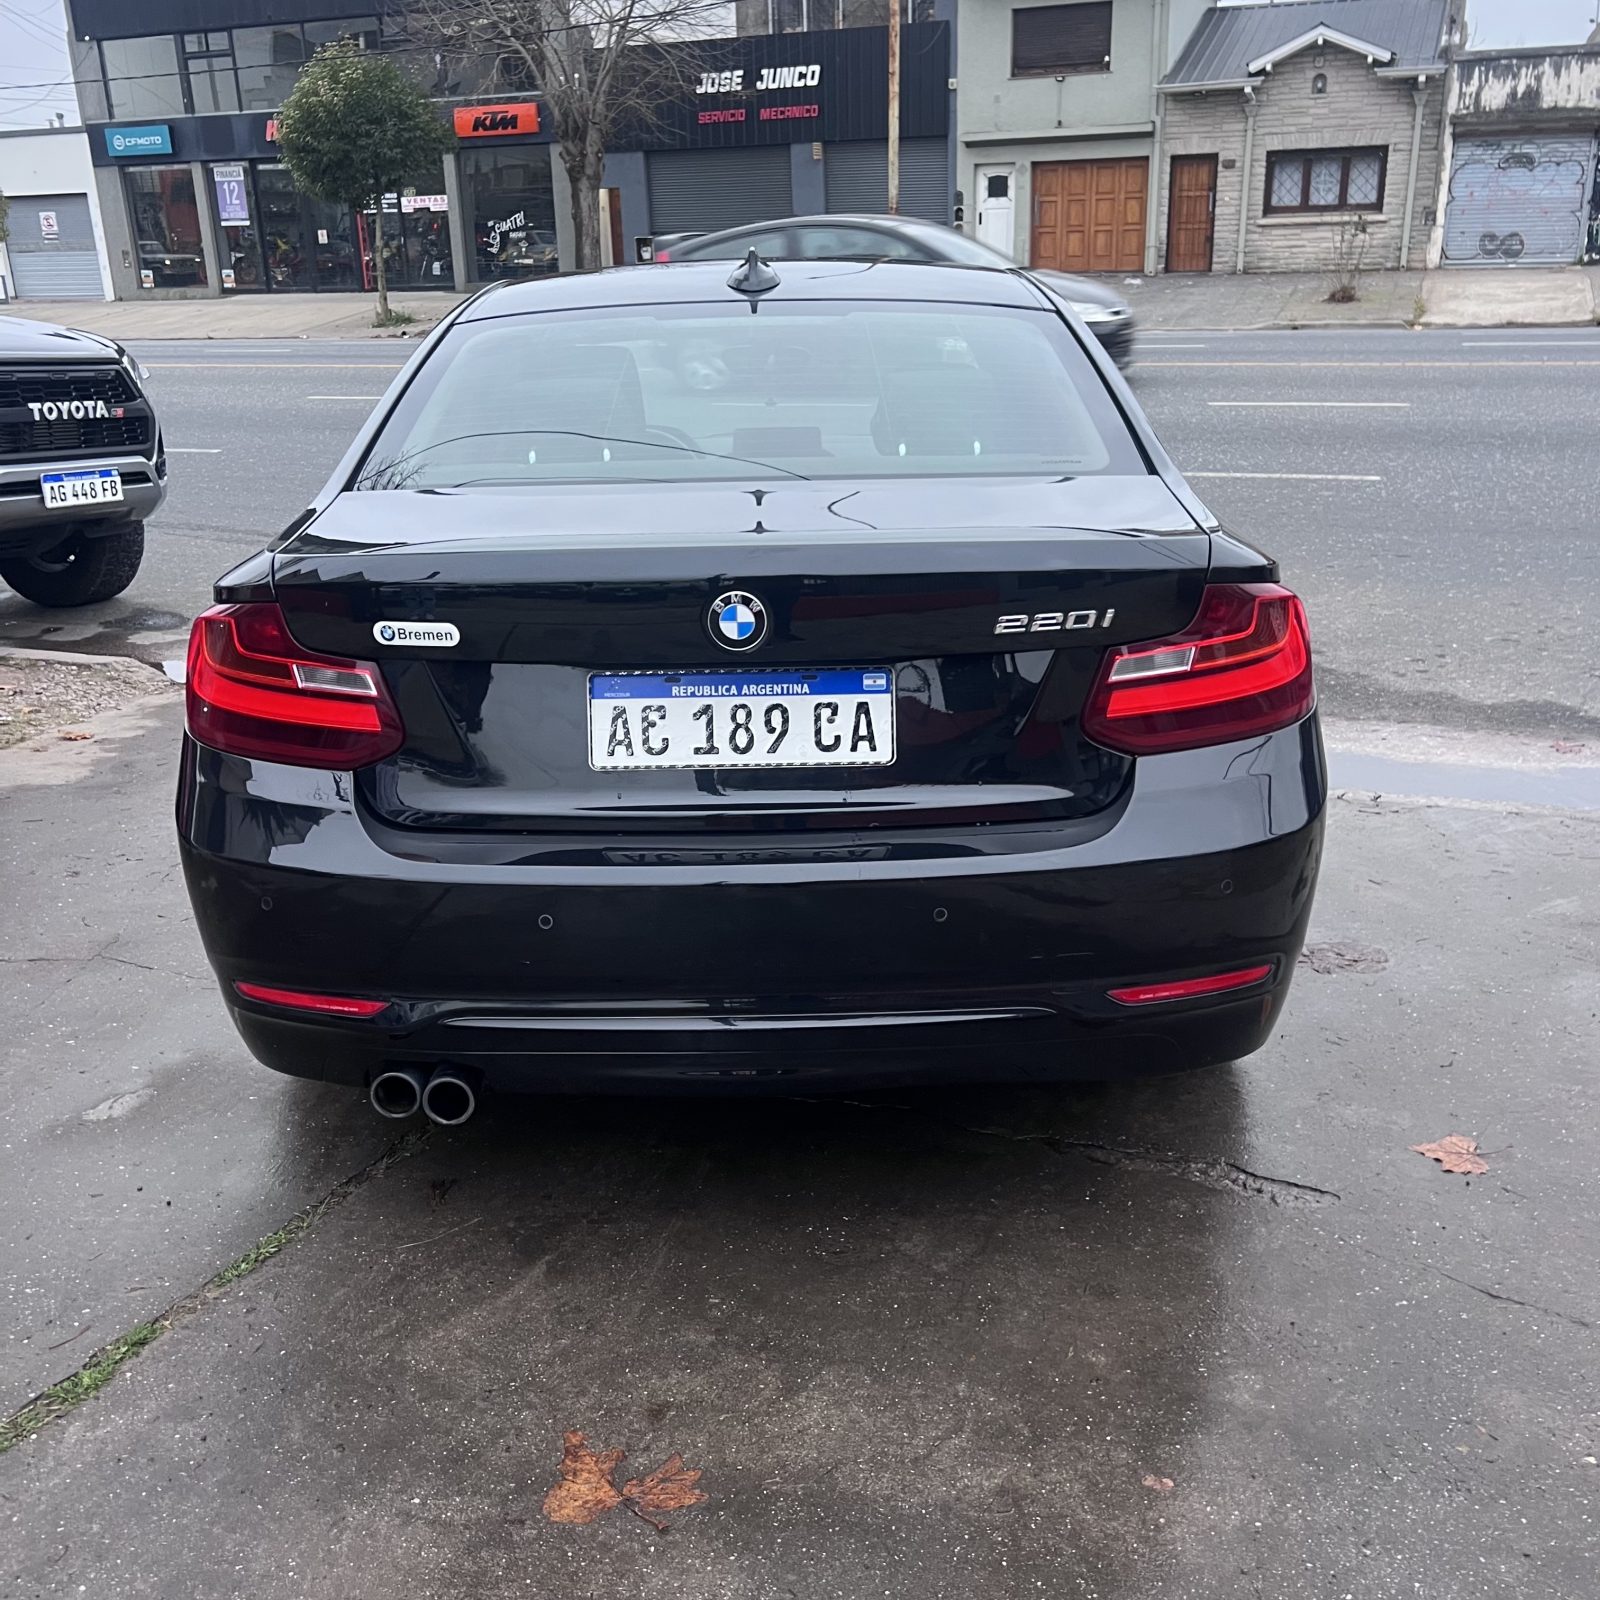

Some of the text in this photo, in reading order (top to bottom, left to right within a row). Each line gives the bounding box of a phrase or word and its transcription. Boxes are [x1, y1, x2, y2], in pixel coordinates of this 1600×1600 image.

[696, 65, 821, 94] JOSE JUNCO
[472, 110, 518, 132] KTM
[698, 104, 819, 124] SERVICIO MECANICO
[125, 136, 162, 146] CFMOTO
[223, 181, 239, 204] 12
[406, 196, 446, 204] VENTAS
[28, 401, 109, 421] TOYOTA
[50, 480, 118, 503] AG 448 FB
[713, 593, 762, 613] BMW
[994, 608, 1115, 634] 220i
[397, 628, 454, 641] Bremen
[671, 683, 810, 697] REPUBLICA ARGENTINA
[606, 701, 878, 757] AC 189 CA
